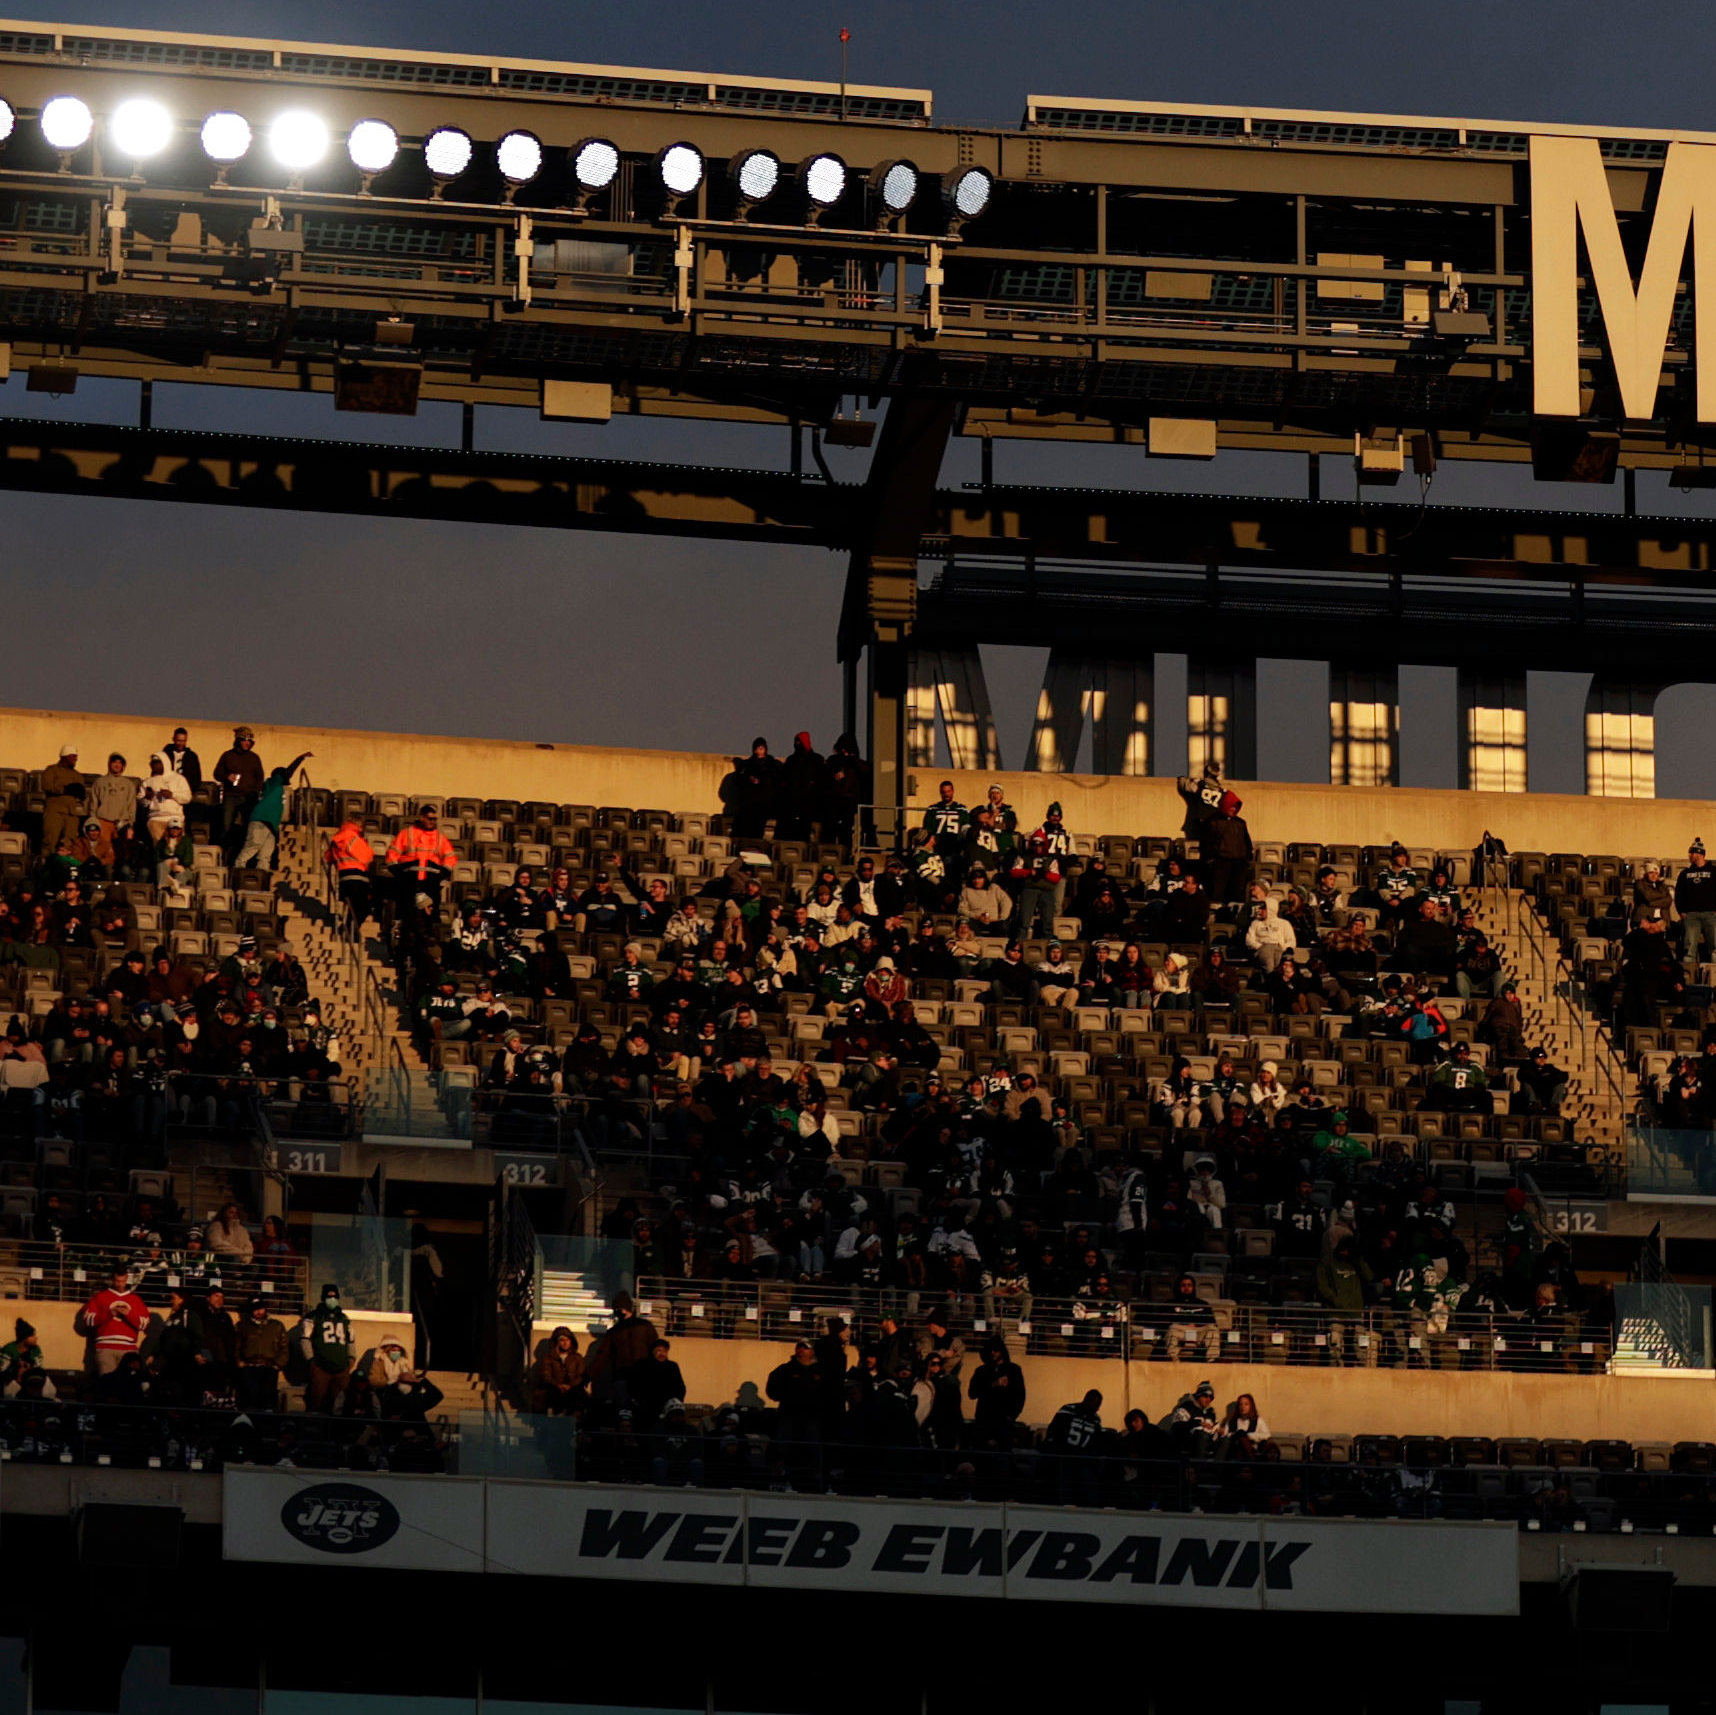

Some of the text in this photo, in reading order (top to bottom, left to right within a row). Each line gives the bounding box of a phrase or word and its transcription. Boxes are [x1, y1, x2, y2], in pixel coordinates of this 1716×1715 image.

[936, 814, 959, 835] 75
[1048, 833, 1066, 855] 74
[989, 1077, 1012, 1094] 24
[1454, 1071, 1467, 1089] 8
[287, 1150, 327, 1171] 311
[505, 1162, 546, 1185] 312
[1556, 1210, 1597, 1232] 312
[1395, 1268, 1414, 1292] 12
[322, 1321, 347, 1345] 24
[297, 1503, 380, 1528] JETS
[578, 1508, 1313, 1592] WEEB EWBANK
